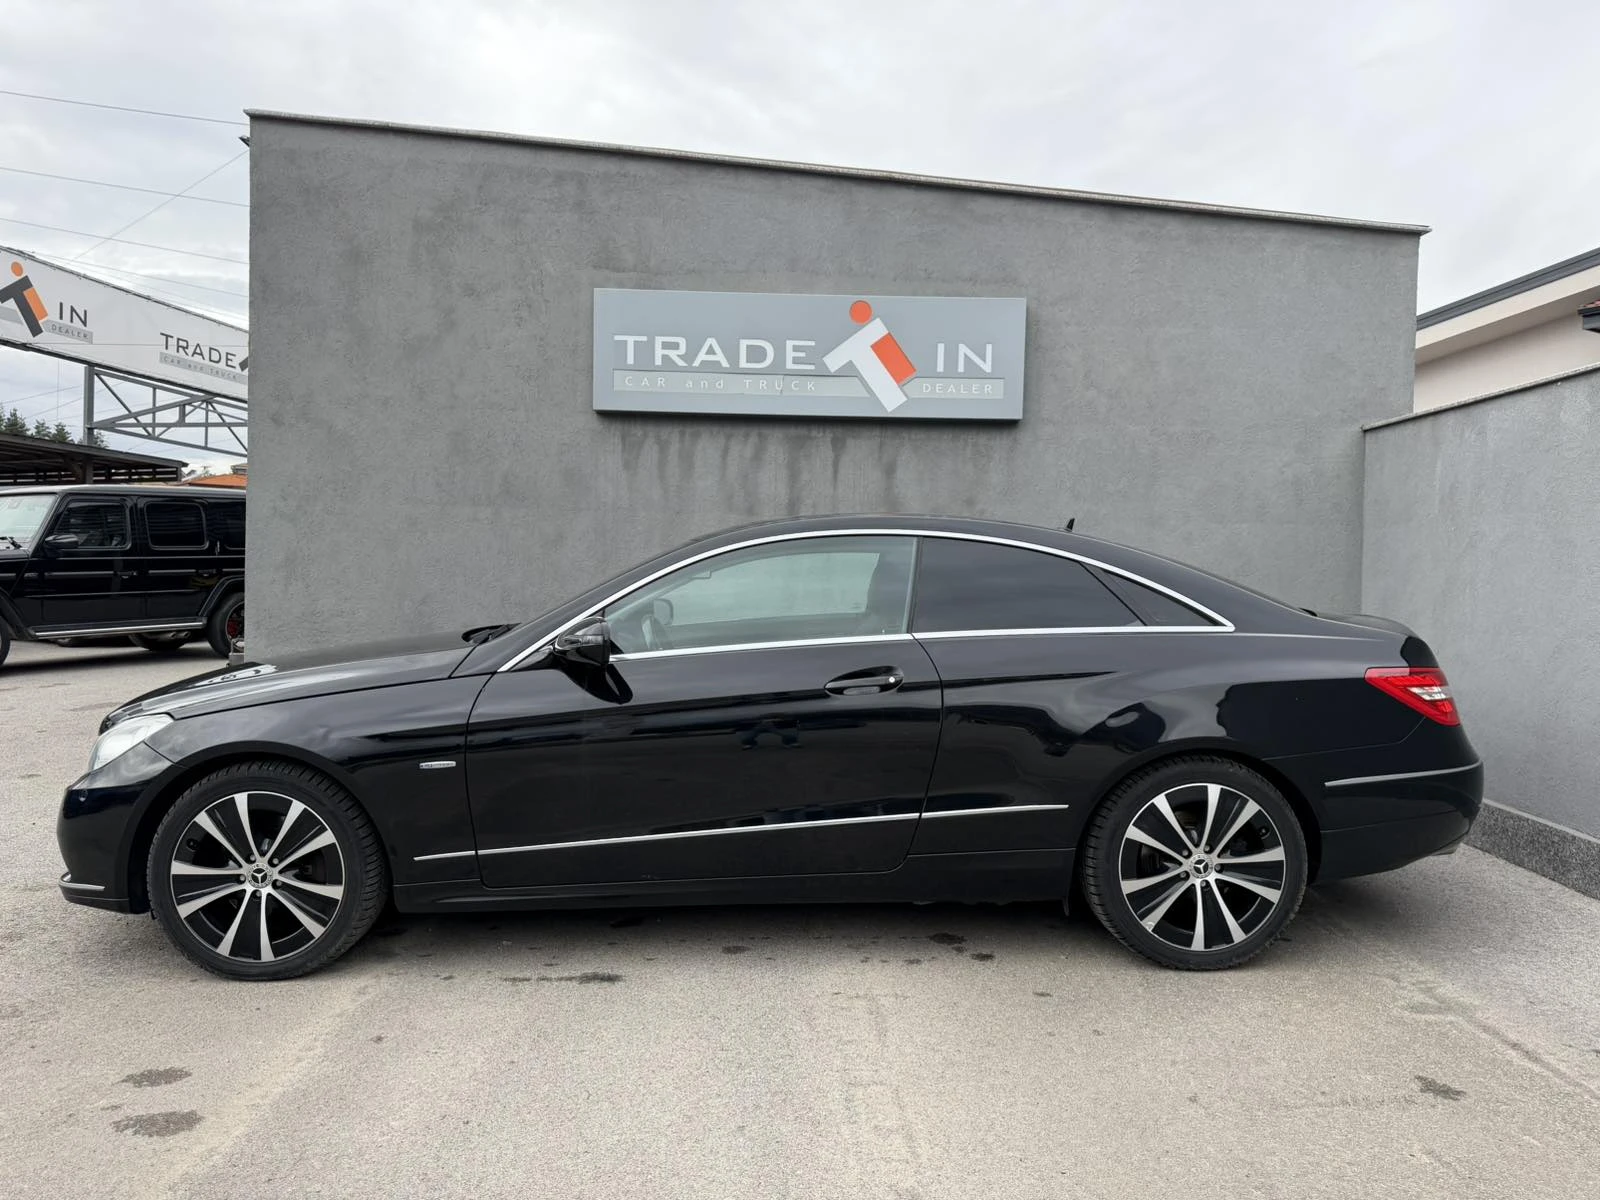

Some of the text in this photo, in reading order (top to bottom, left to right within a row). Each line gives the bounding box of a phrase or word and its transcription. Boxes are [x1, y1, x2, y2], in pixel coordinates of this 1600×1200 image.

[60, 301, 87, 328] IN
[160, 332, 237, 369] TRADE
[614, 335, 993, 373] TRADE IN
[625, 376, 815, 391] CAR and TRUCK
[922, 383, 993, 394] DEALER
